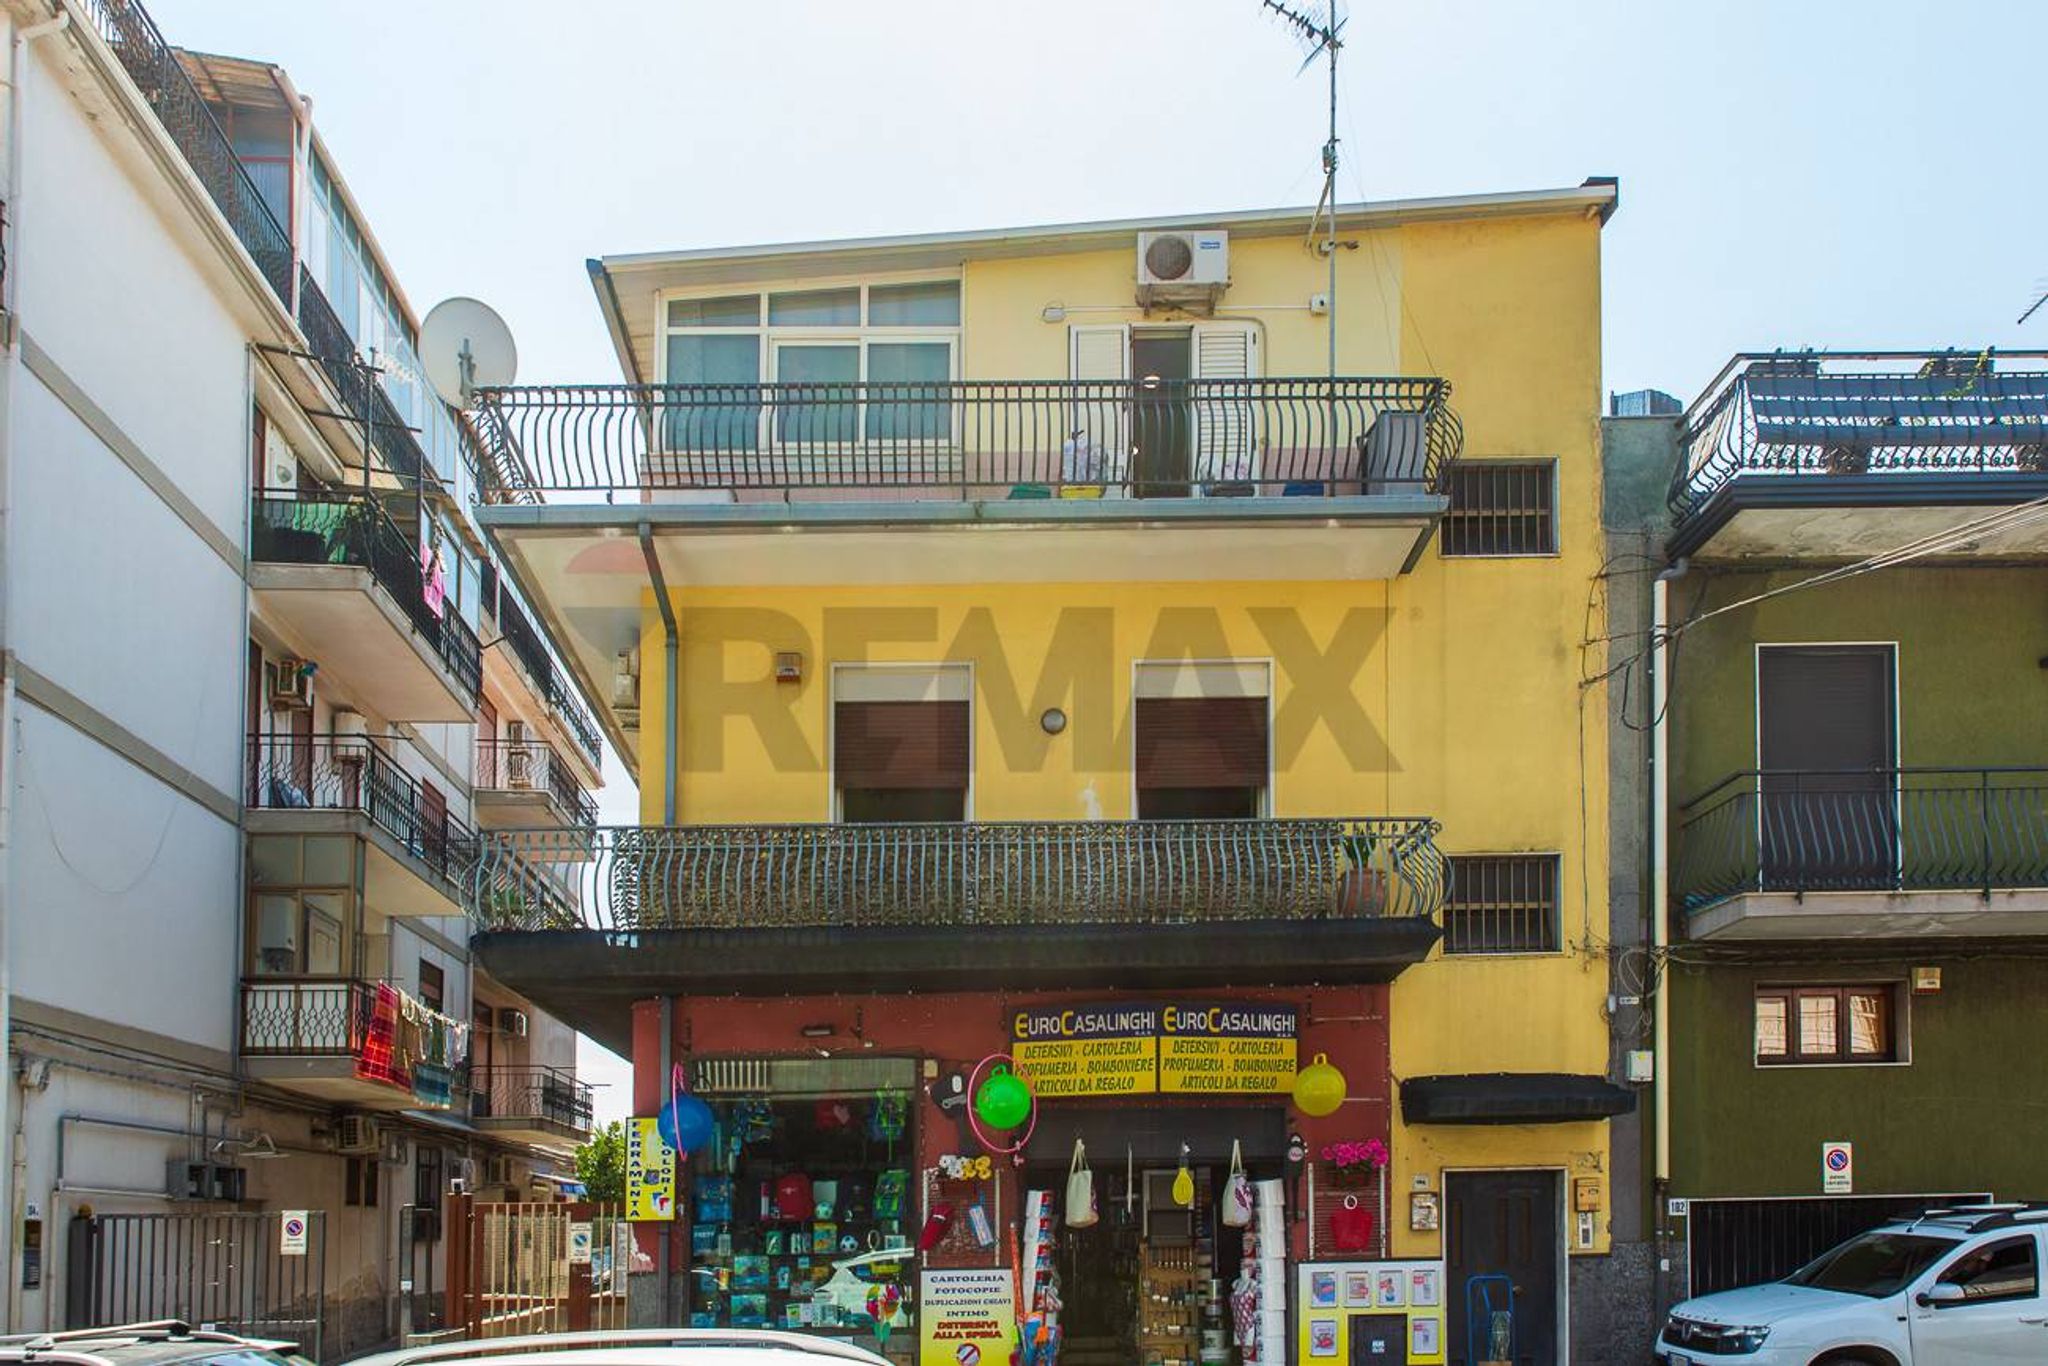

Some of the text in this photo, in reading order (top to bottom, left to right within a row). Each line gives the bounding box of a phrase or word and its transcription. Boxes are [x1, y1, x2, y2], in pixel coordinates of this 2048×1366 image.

[1024, 1044, 1073, 1059] DETERSIVI
[1082, 1040, 1142, 1057] CARTOLERIA
[1172, 1040, 1219, 1053] DETERSIVI
[1228, 1041, 1284, 1055] CARTOLERIA
[1087, 1058, 1154, 1074] BOMBONIERE
[1163, 1058, 1224, 1071] PROFUMERIA
[1233, 1059, 1295, 1073] BOMBONIERE
[1079, 1079, 1092, 1092] DA
[1095, 1077, 1136, 1091] REGALO
[1180, 1076, 1279, 1090] ARTICOLI DA REGALO
[629, 1121, 642, 1217] FERRAMENTA
[661, 1141, 672, 1193] OLORI
[930, 1275, 1004, 1283] CARTOLERIA
[935, 1286, 1001, 1294] FOTOCOPIE
[933, 1331, 963, 1340] ALLA
